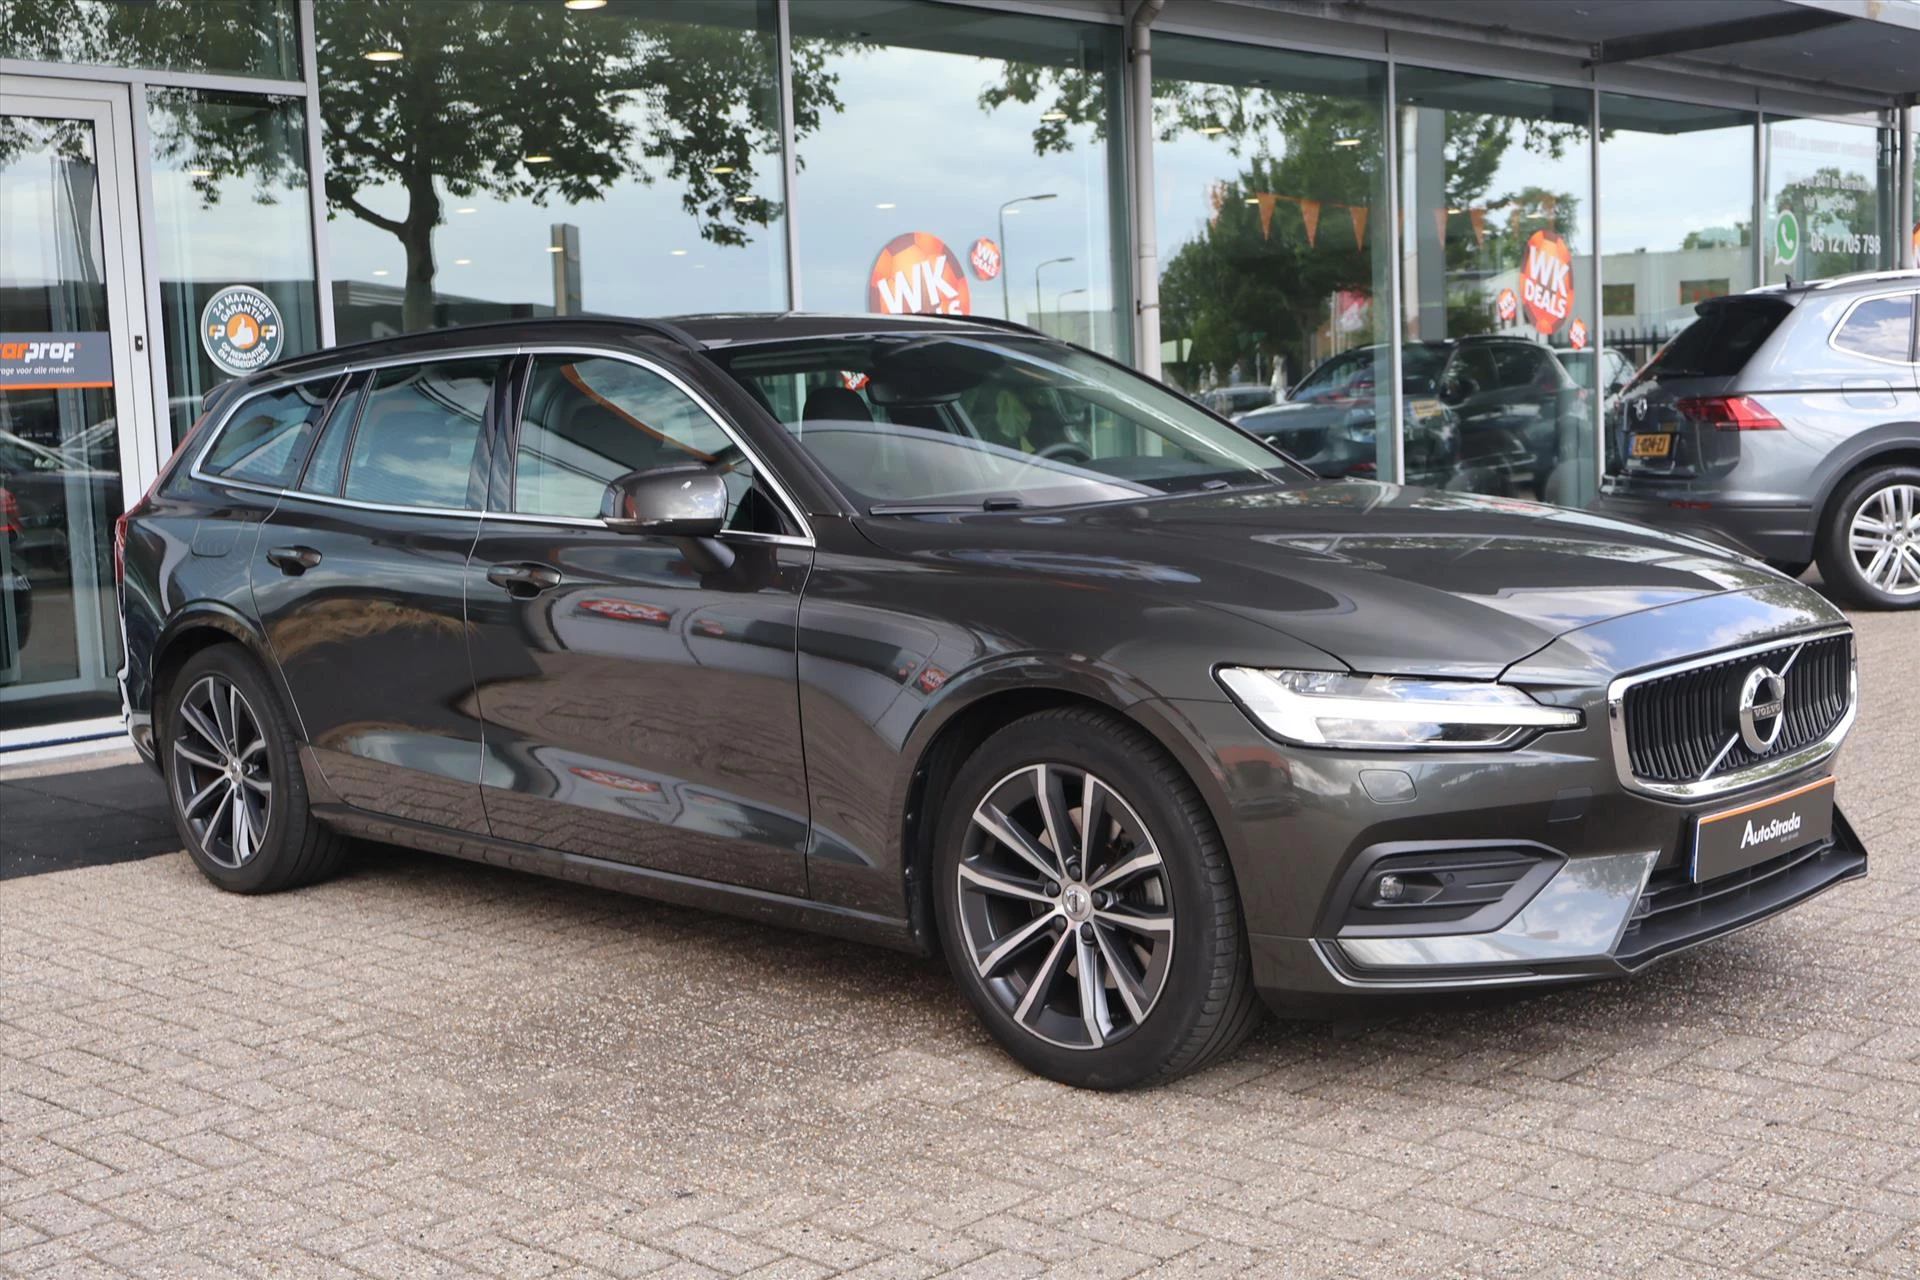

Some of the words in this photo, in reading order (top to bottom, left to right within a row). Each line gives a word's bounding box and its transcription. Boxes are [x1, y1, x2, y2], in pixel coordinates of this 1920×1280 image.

[1811, 232, 1824, 253] 06
[1862, 234, 1881, 255] 798
[1530, 245, 1570, 298] WK
[877, 255, 959, 314] WK
[212, 302, 225, 317] 24
[224, 293, 272, 318] MAANDEN
[1524, 278, 1568, 319] DEALS
[220, 303, 265, 323] GARANTIE
[16, 367, 32, 375] voor
[33, 366, 47, 375] alle
[48, 365, 75, 375] merken
[1753, 703, 1781, 717] VOLVO
[1740, 811, 1801, 849] AutoStrada
